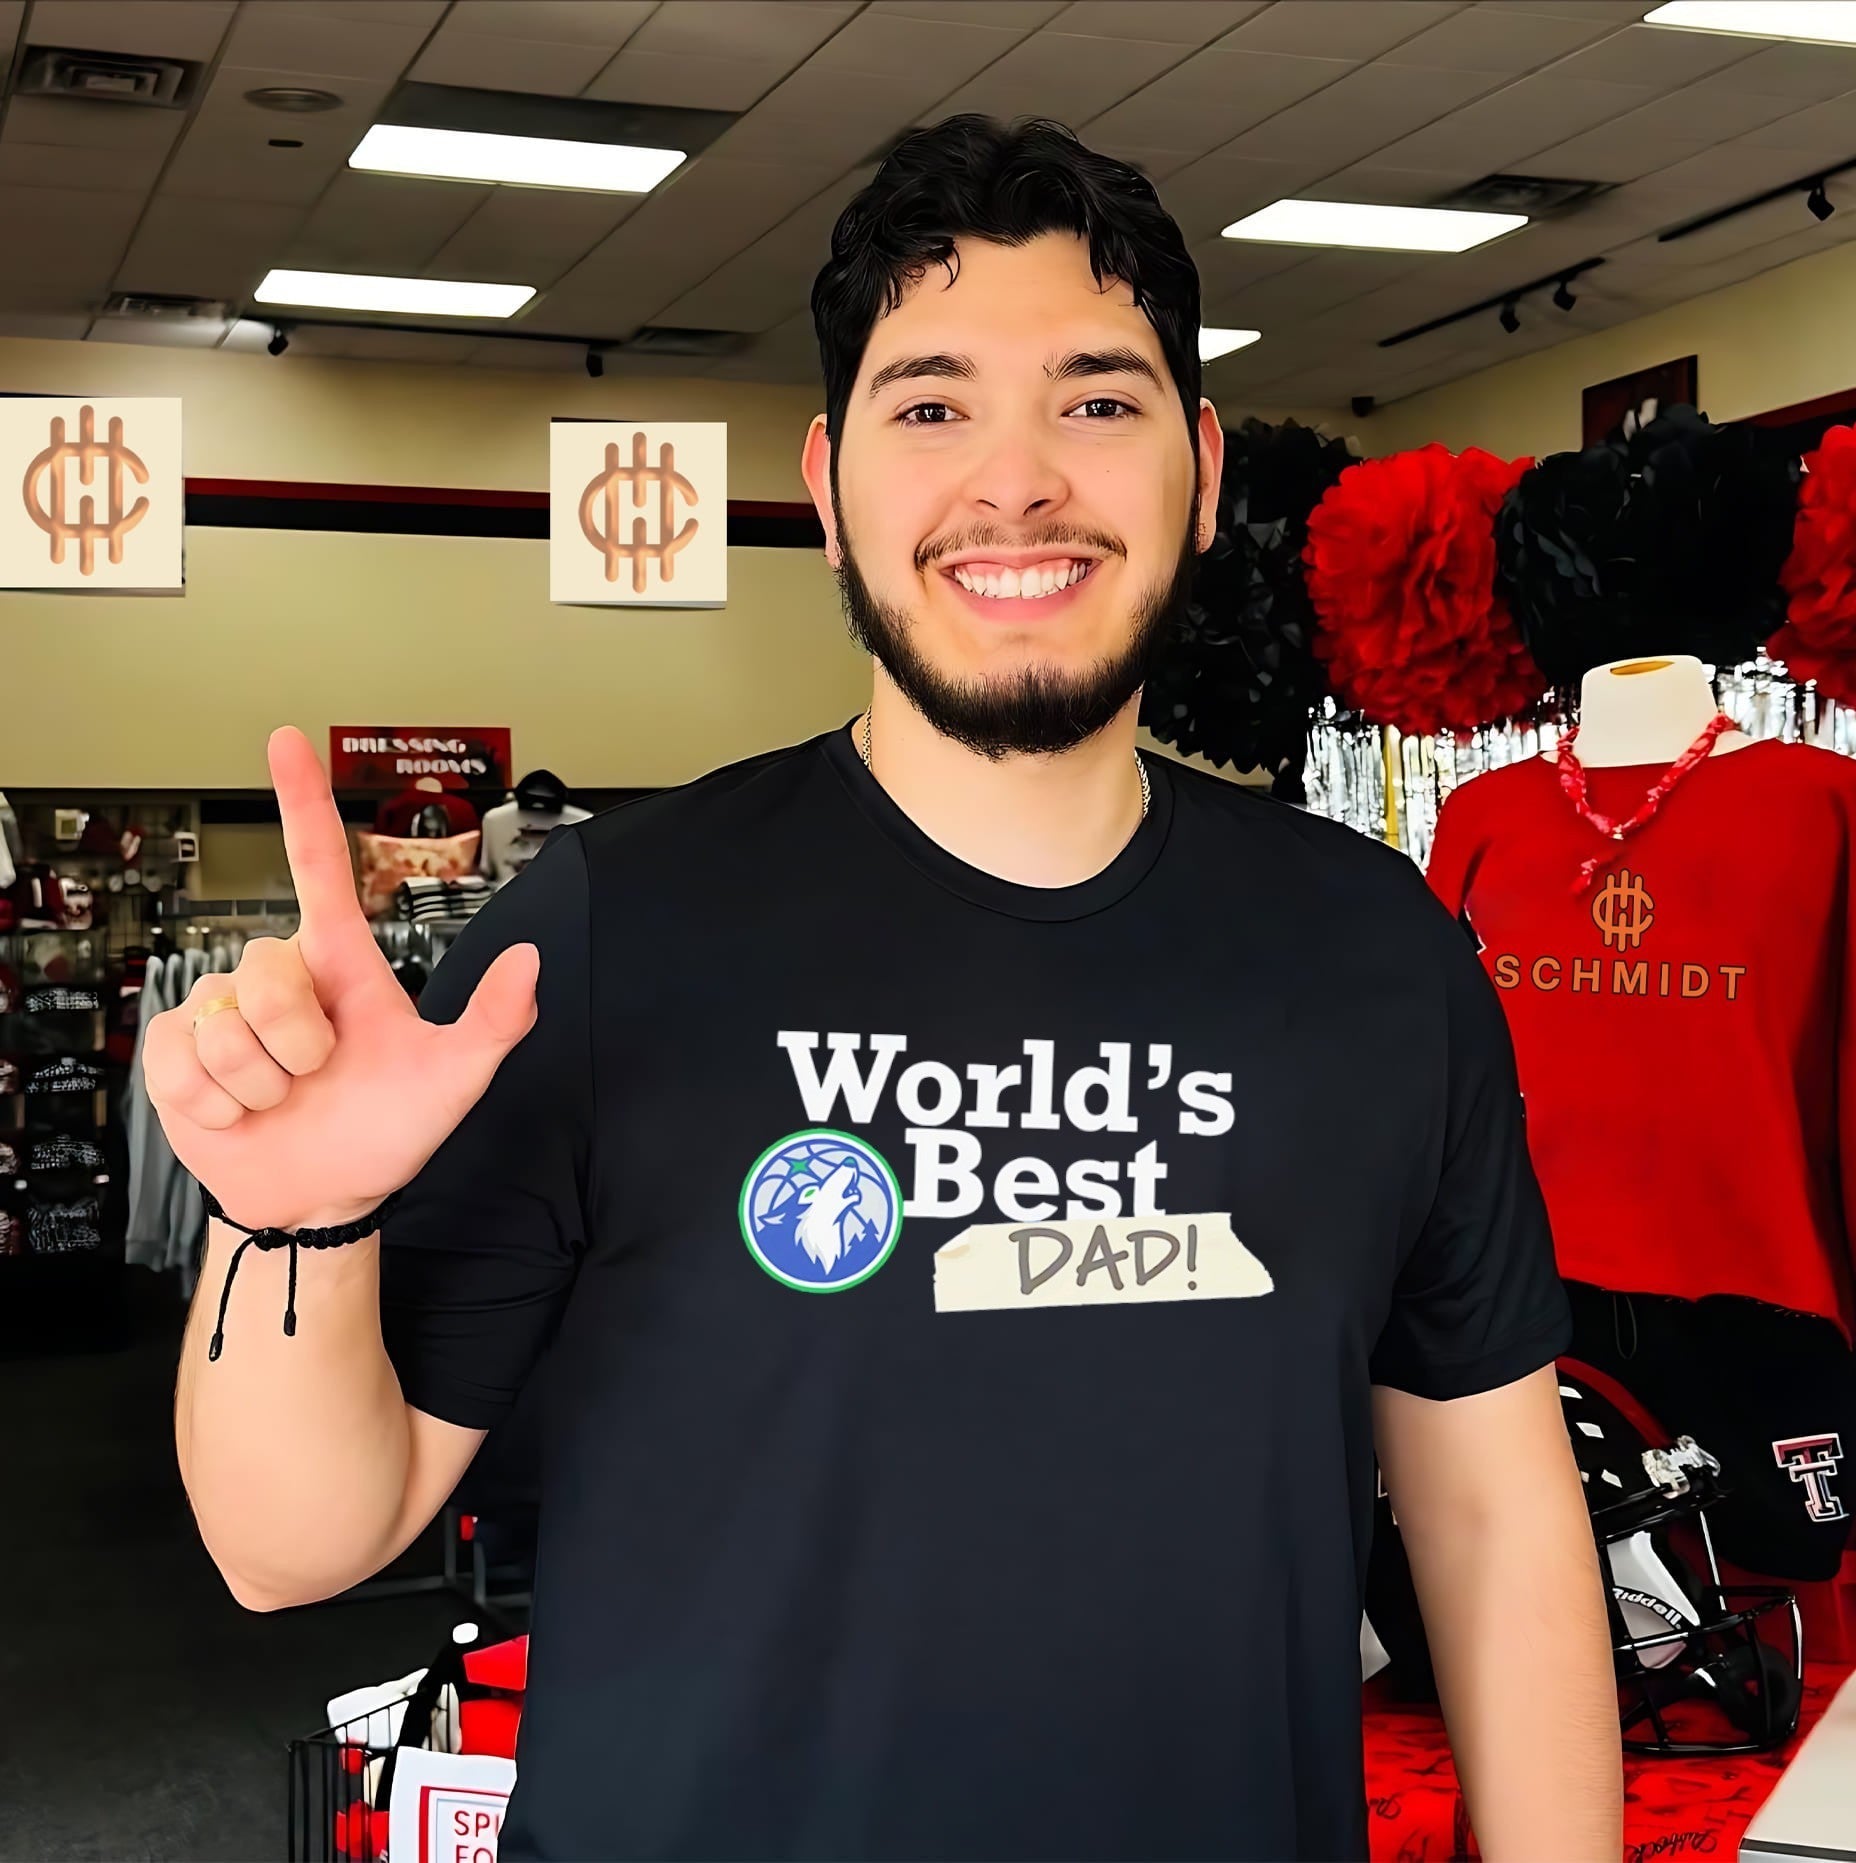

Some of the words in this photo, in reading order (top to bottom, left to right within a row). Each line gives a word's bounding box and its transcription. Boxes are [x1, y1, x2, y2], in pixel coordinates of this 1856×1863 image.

[342, 737, 467, 754] DRESSING
[396, 758, 487, 775] ROOMS
[1495, 955, 1747, 1000] SCHMIDT
[777, 1030, 1236, 1137] World's
[903, 1127, 1168, 1222] Best
[1008, 1223, 1198, 1295] DAD!
